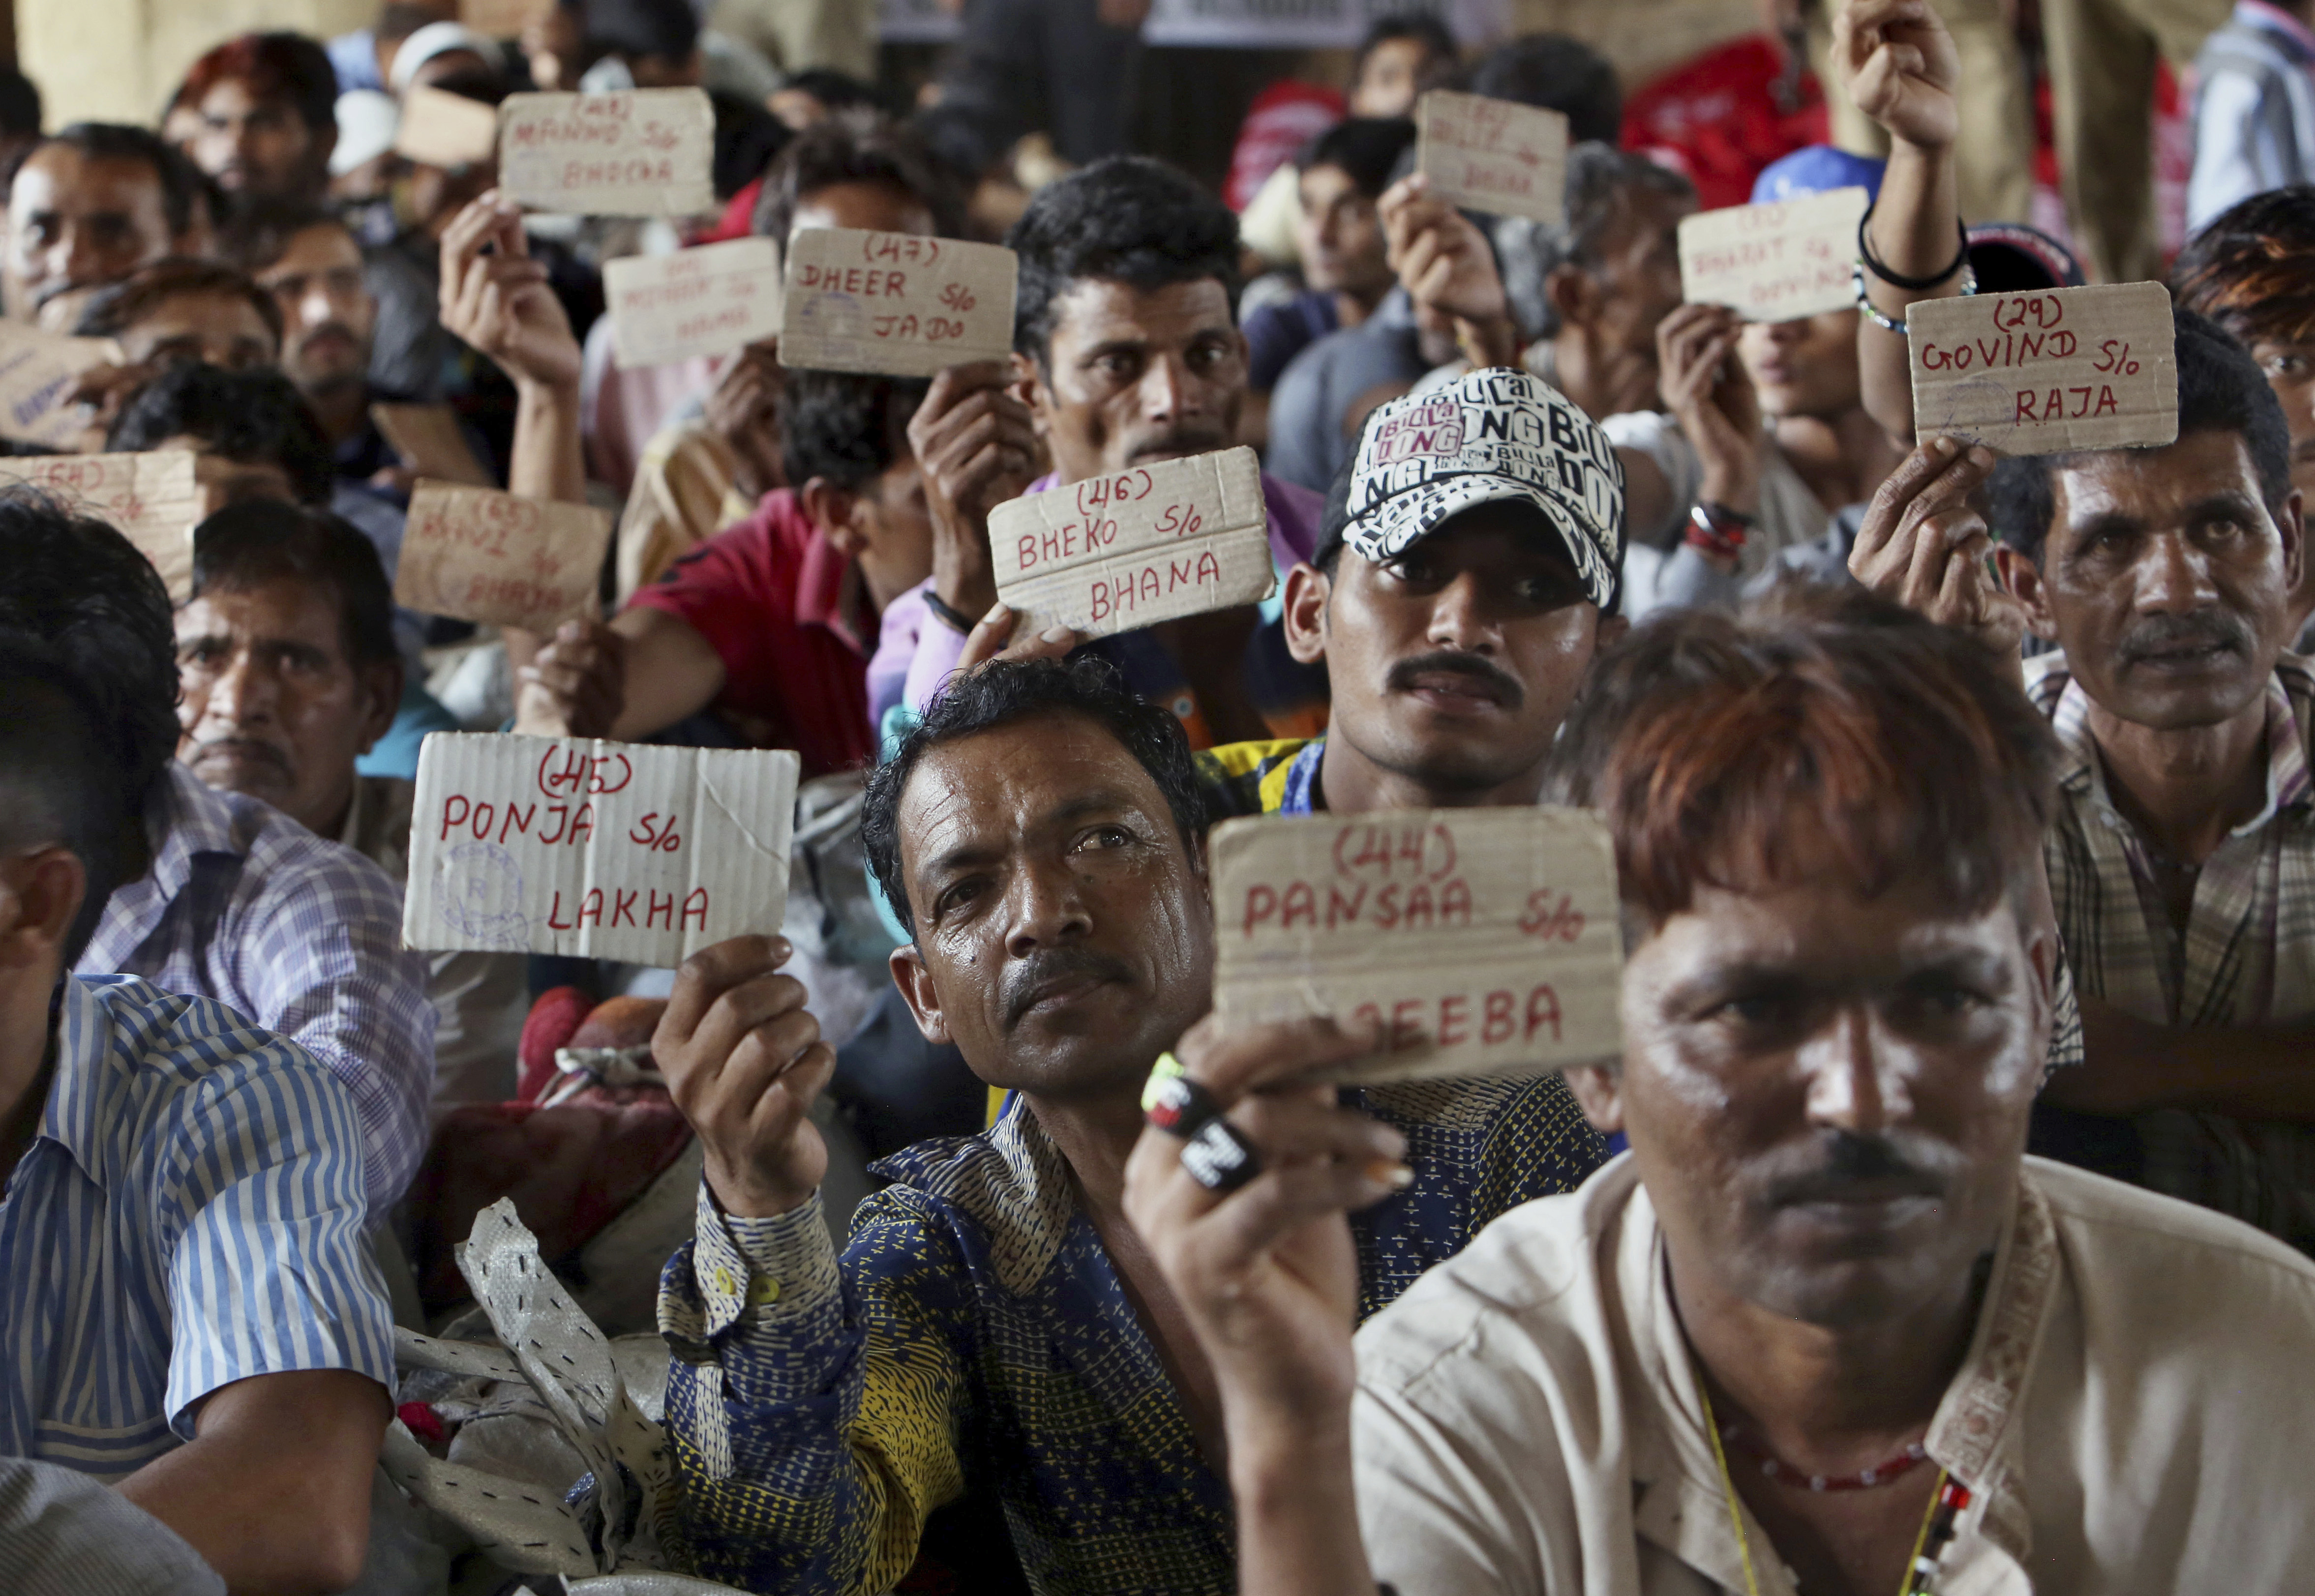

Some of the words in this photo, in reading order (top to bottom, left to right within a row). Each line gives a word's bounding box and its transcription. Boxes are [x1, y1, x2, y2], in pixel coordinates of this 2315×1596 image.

[862, 233, 939, 268] (47)
[797, 265, 906, 297] DHEER
[873, 315, 965, 341] JADO
[1994, 295, 2063, 333] (29)
[1923, 330, 2077, 370] GOVIND
[2017, 385, 2118, 426] RAJA
[1077, 470, 1153, 516] (46)
[1018, 520, 1117, 571] BHEKO
[1091, 552, 1219, 622] BHANA
[539, 745, 632, 799] (45)
[441, 795, 595, 846] PONJA
[1332, 823, 1457, 883] (44)
[548, 887, 708, 932] LAKHA
[1241, 879, 1473, 938] PANSAA
